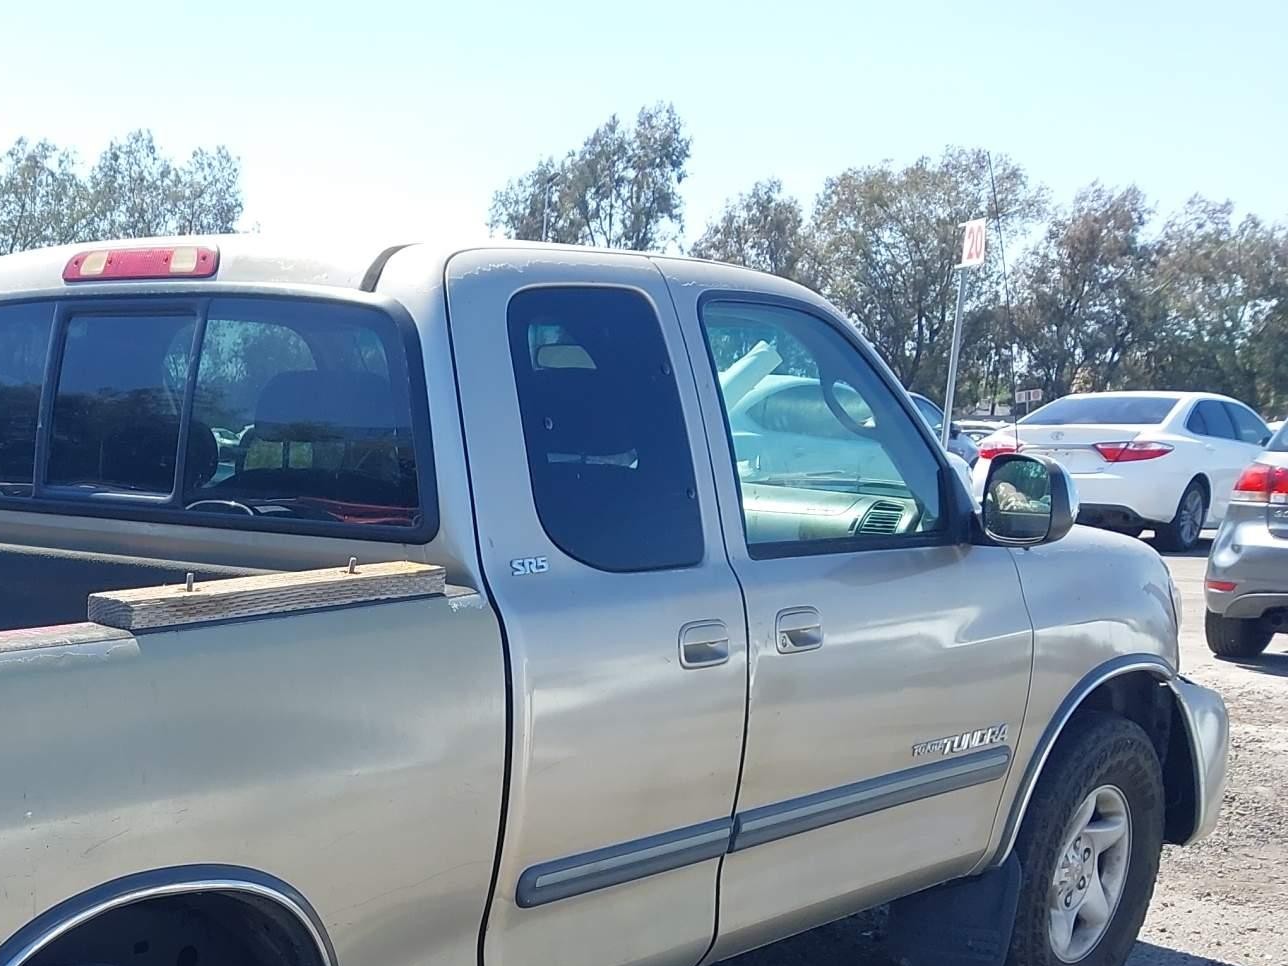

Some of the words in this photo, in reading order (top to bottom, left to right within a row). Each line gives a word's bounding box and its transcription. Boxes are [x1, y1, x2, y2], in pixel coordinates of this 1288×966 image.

[966, 225, 983, 260] 20
[510, 556, 549, 576] SR5
[943, 724, 1008, 755] TUNDRA
